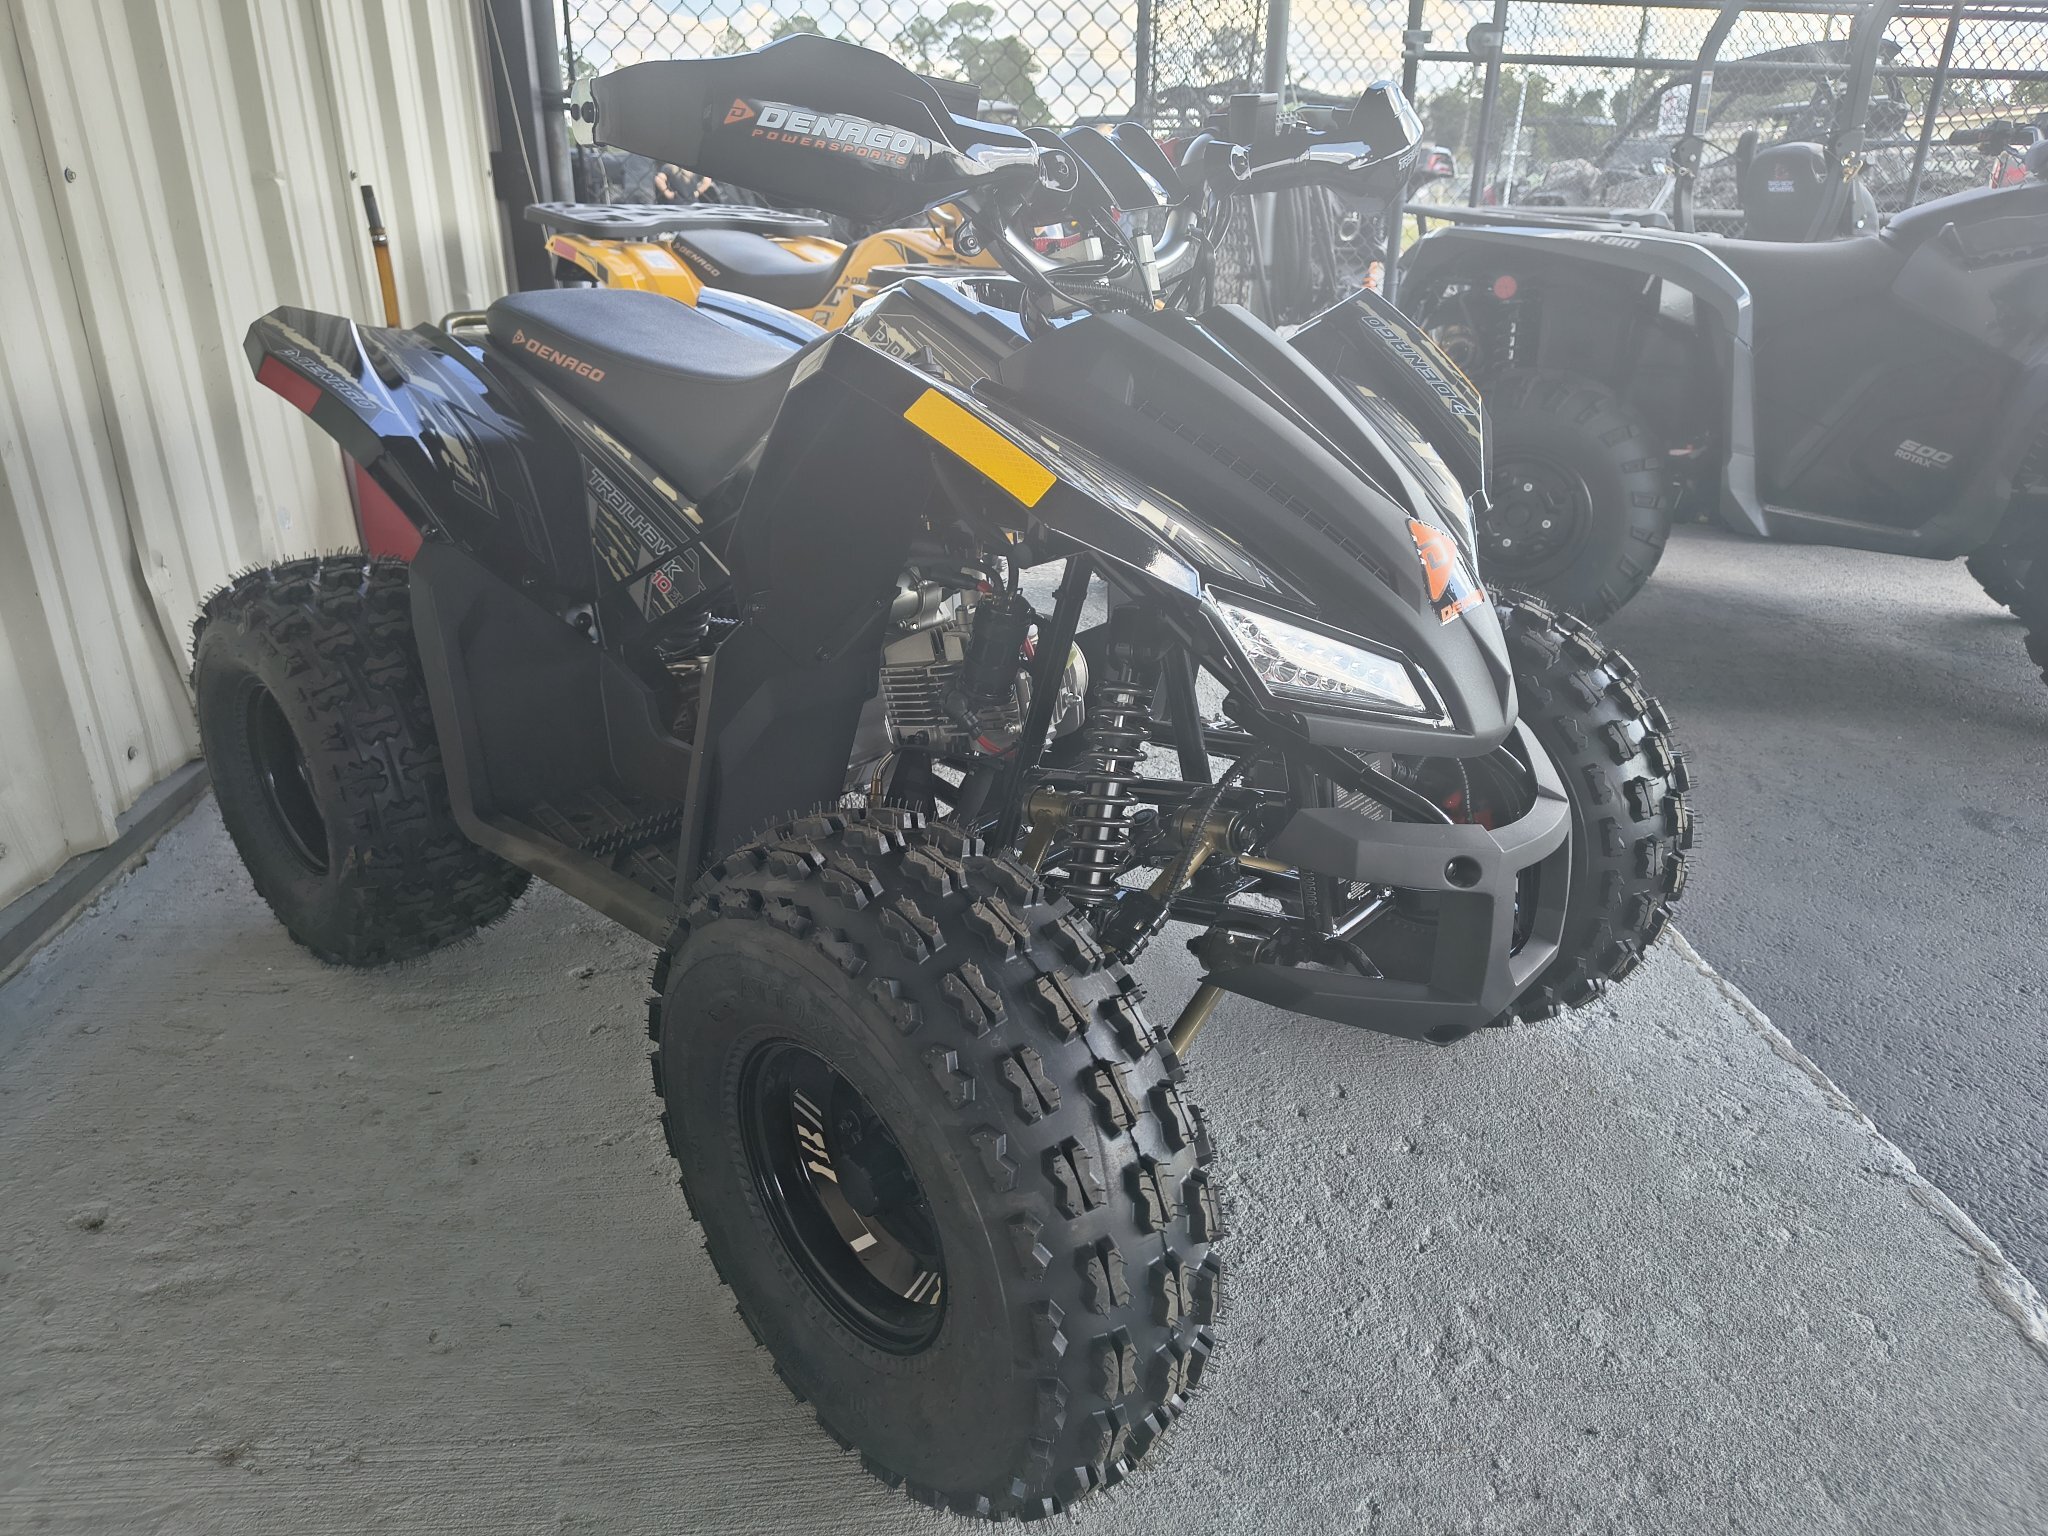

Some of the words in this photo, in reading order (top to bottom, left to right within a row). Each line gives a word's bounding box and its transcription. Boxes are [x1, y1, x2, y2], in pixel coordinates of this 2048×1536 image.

[752, 128, 908, 166] POWERSPORTS
[756, 105, 916, 154] DENAGO
[679, 246, 720, 278] DENAGO
[525, 338, 606, 382] DENAGO
[1361, 315, 1458, 398] DENAGO
[1894, 449, 1932, 468] ROTAX
[1899, 439, 1954, 463] 500
[651, 570, 673, 594] 10
